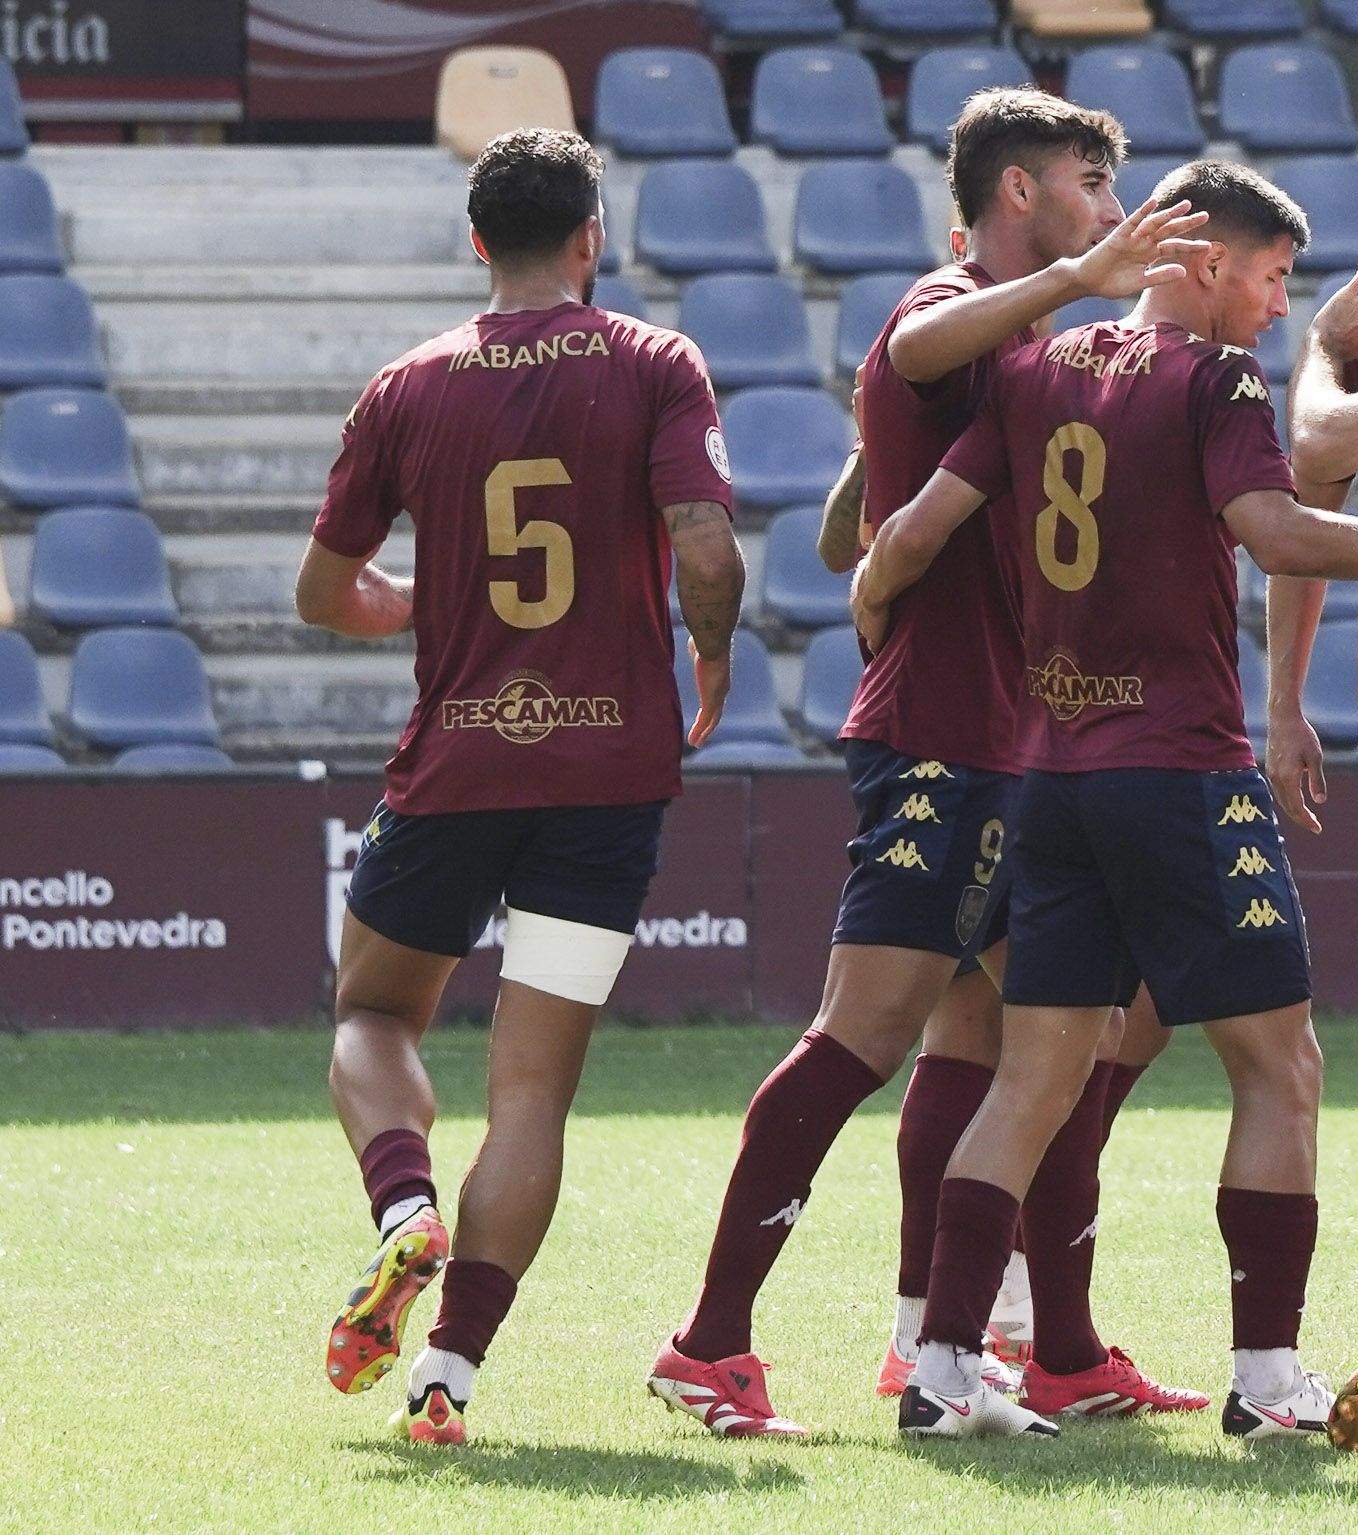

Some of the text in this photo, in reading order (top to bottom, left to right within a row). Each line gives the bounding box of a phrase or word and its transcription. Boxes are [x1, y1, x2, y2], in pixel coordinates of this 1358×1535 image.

[1036, 421, 1107, 592] 8
[485, 458, 575, 629] 5
[443, 698, 624, 730] PESCAMAR
[974, 818, 1005, 885] 9
[0, 869, 114, 907] ncello
[2, 911, 227, 949] Pontevedra
